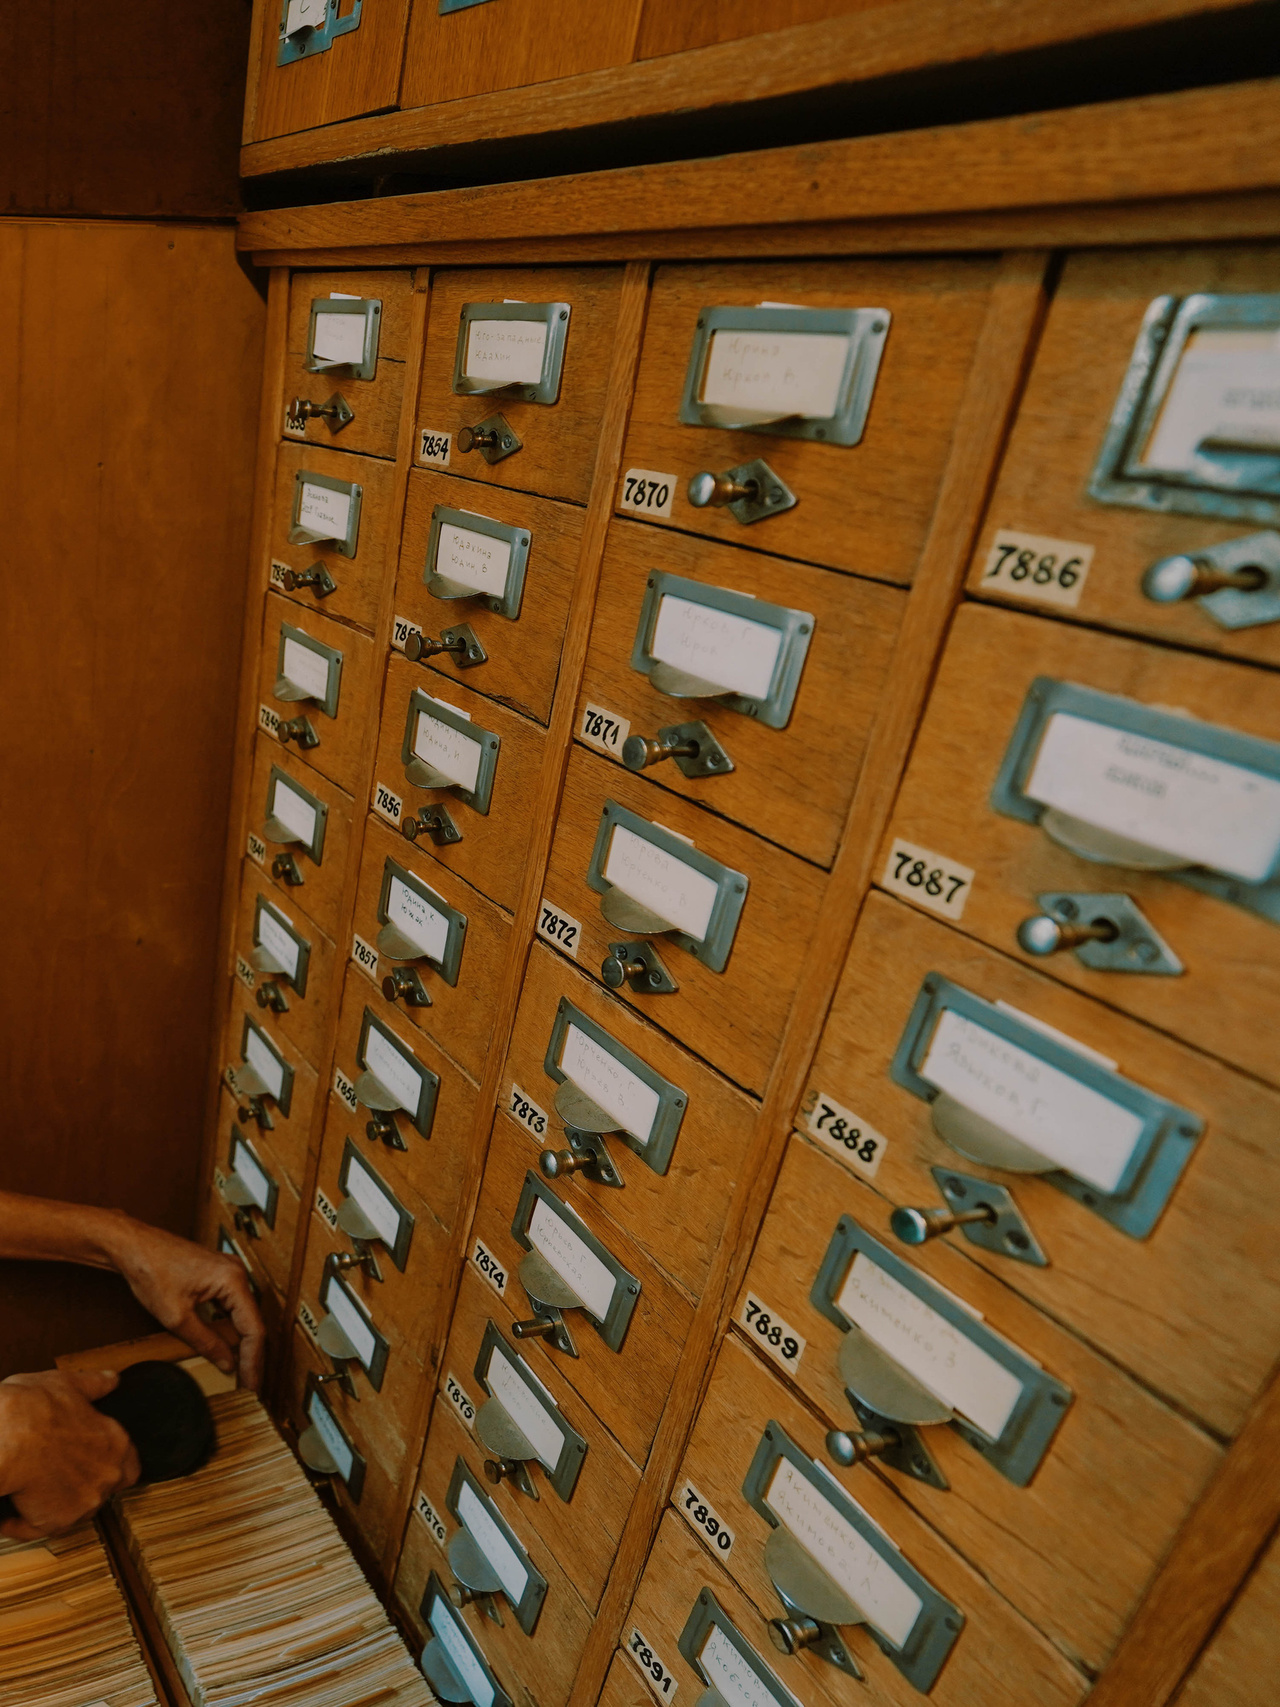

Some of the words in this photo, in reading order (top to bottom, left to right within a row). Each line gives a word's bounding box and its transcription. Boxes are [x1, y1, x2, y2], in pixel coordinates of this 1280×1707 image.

[421, 434, 449, 460] 7854
[625, 478, 669, 508] 7870
[988, 545, 1083, 588] 7886
[261, 708, 279, 731] 7840
[585, 710, 620, 745] 7871
[378, 788, 401, 817] 7856
[249, 836, 265, 860] 7841
[895, 852, 967, 903] 7887
[541, 908, 577, 948] 7872
[355, 940, 378, 969] 7857
[336, 1075, 358, 1107] 7858
[512, 1092, 546, 1133] 7873
[816, 1103, 878, 1163] 7888
[476, 1245, 505, 1289] 7874
[745, 1300, 799, 1359] 7889
[447, 1378, 475, 1419] 7875
[420, 1496, 445, 1540] 7876
[686, 1488, 731, 1549] 7890
[632, 1632, 672, 1693] 7891
